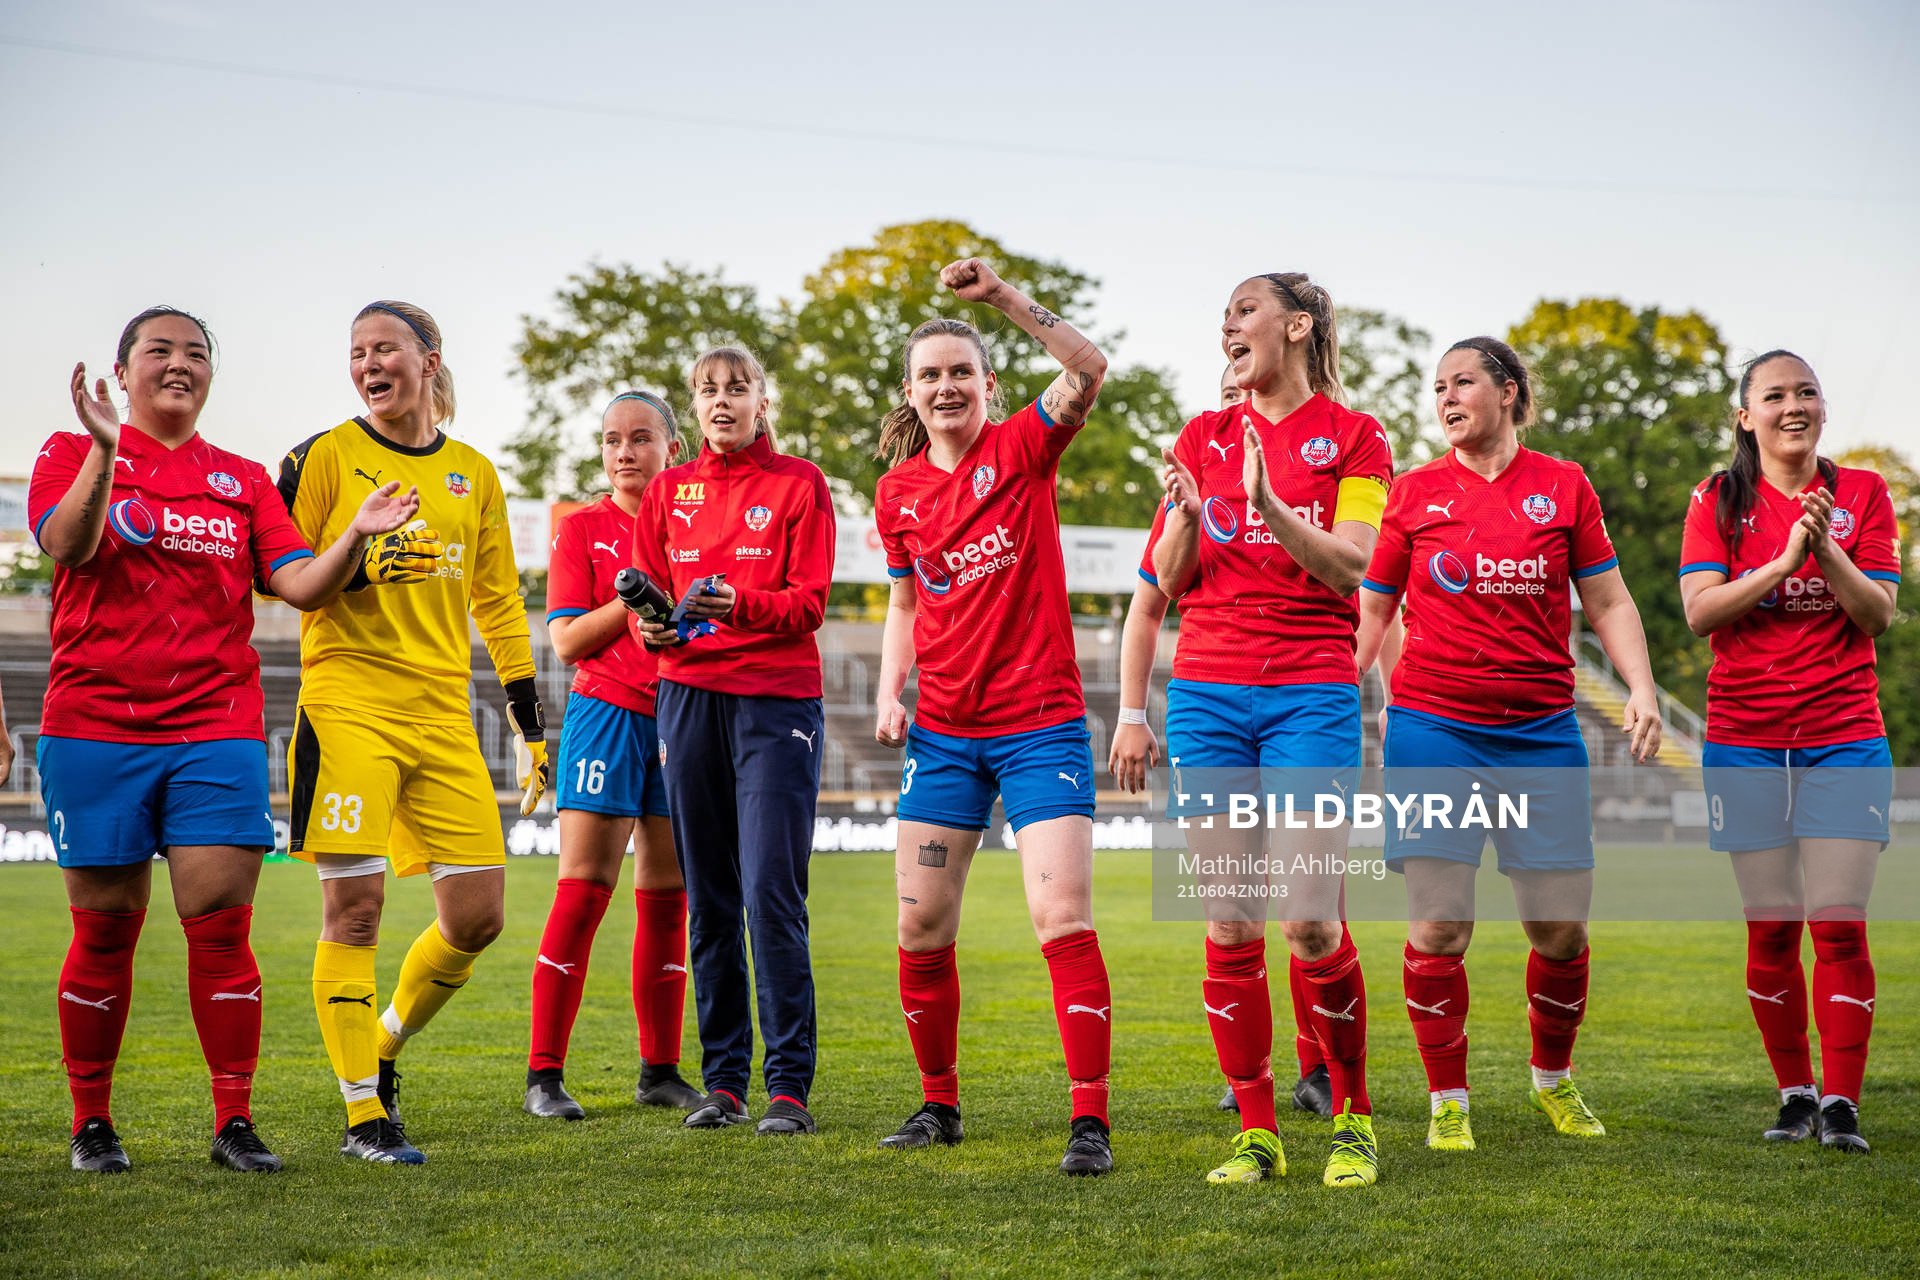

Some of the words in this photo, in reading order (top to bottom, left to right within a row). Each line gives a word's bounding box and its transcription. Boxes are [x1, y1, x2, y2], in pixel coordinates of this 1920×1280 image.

[674, 483, 705, 500] XXL
[163, 506, 238, 542] beat
[1245, 499, 1325, 529] bat
[161, 534, 236, 559] diabetes
[679, 547, 700, 558] beat
[735, 545, 762, 556] akea
[941, 524, 1014, 573] beat
[956, 552, 1018, 586] diabetes
[1476, 552, 1548, 579] beat
[1475, 579, 1545, 595] diabetes
[576, 758, 606, 795] 16
[901, 756, 918, 796] 3
[321, 792, 363, 834] 33
[1398, 802, 1423, 841] 2
[1711, 794, 1724, 832] 9
